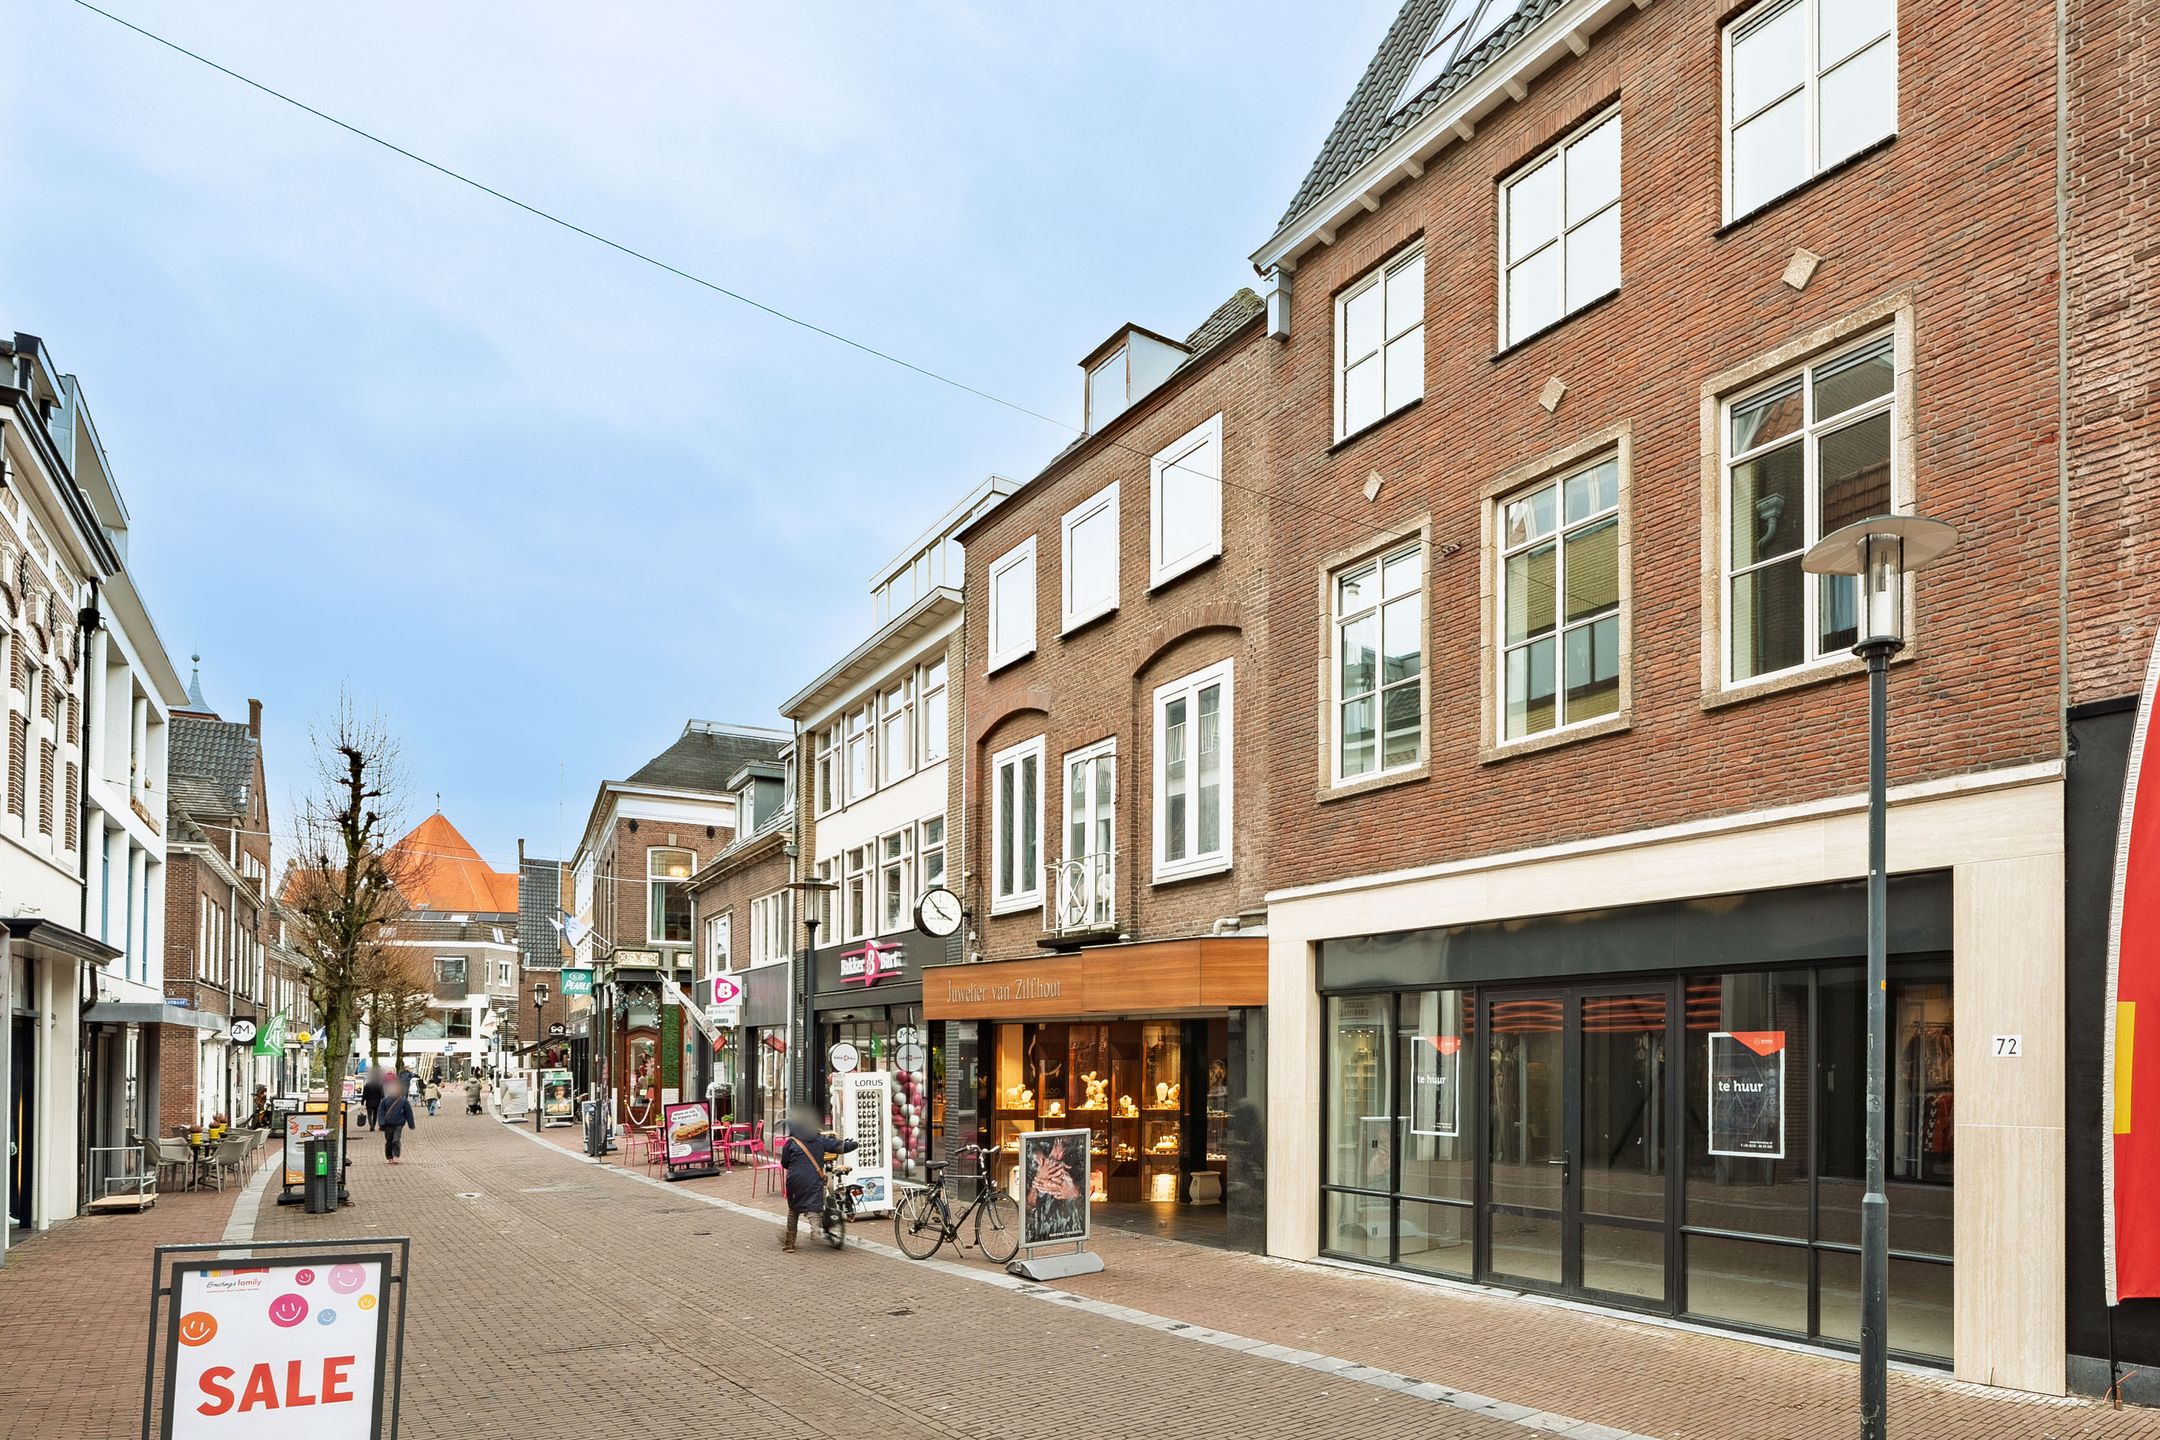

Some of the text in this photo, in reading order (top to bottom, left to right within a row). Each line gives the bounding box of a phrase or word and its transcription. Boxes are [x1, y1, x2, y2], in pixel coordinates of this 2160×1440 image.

[564, 980, 591, 991] PEARLE
[947, 977, 1062, 1003] Juwelier van Zilfhout
[1996, 1038, 2017, 1055] 72
[855, 1080, 883, 1088] LORUS
[1417, 1075, 1446, 1084] te huur
[1718, 1080, 1763, 1092] te huur
[237, 1278, 262, 1287] family
[197, 1355, 355, 1416] SALE
